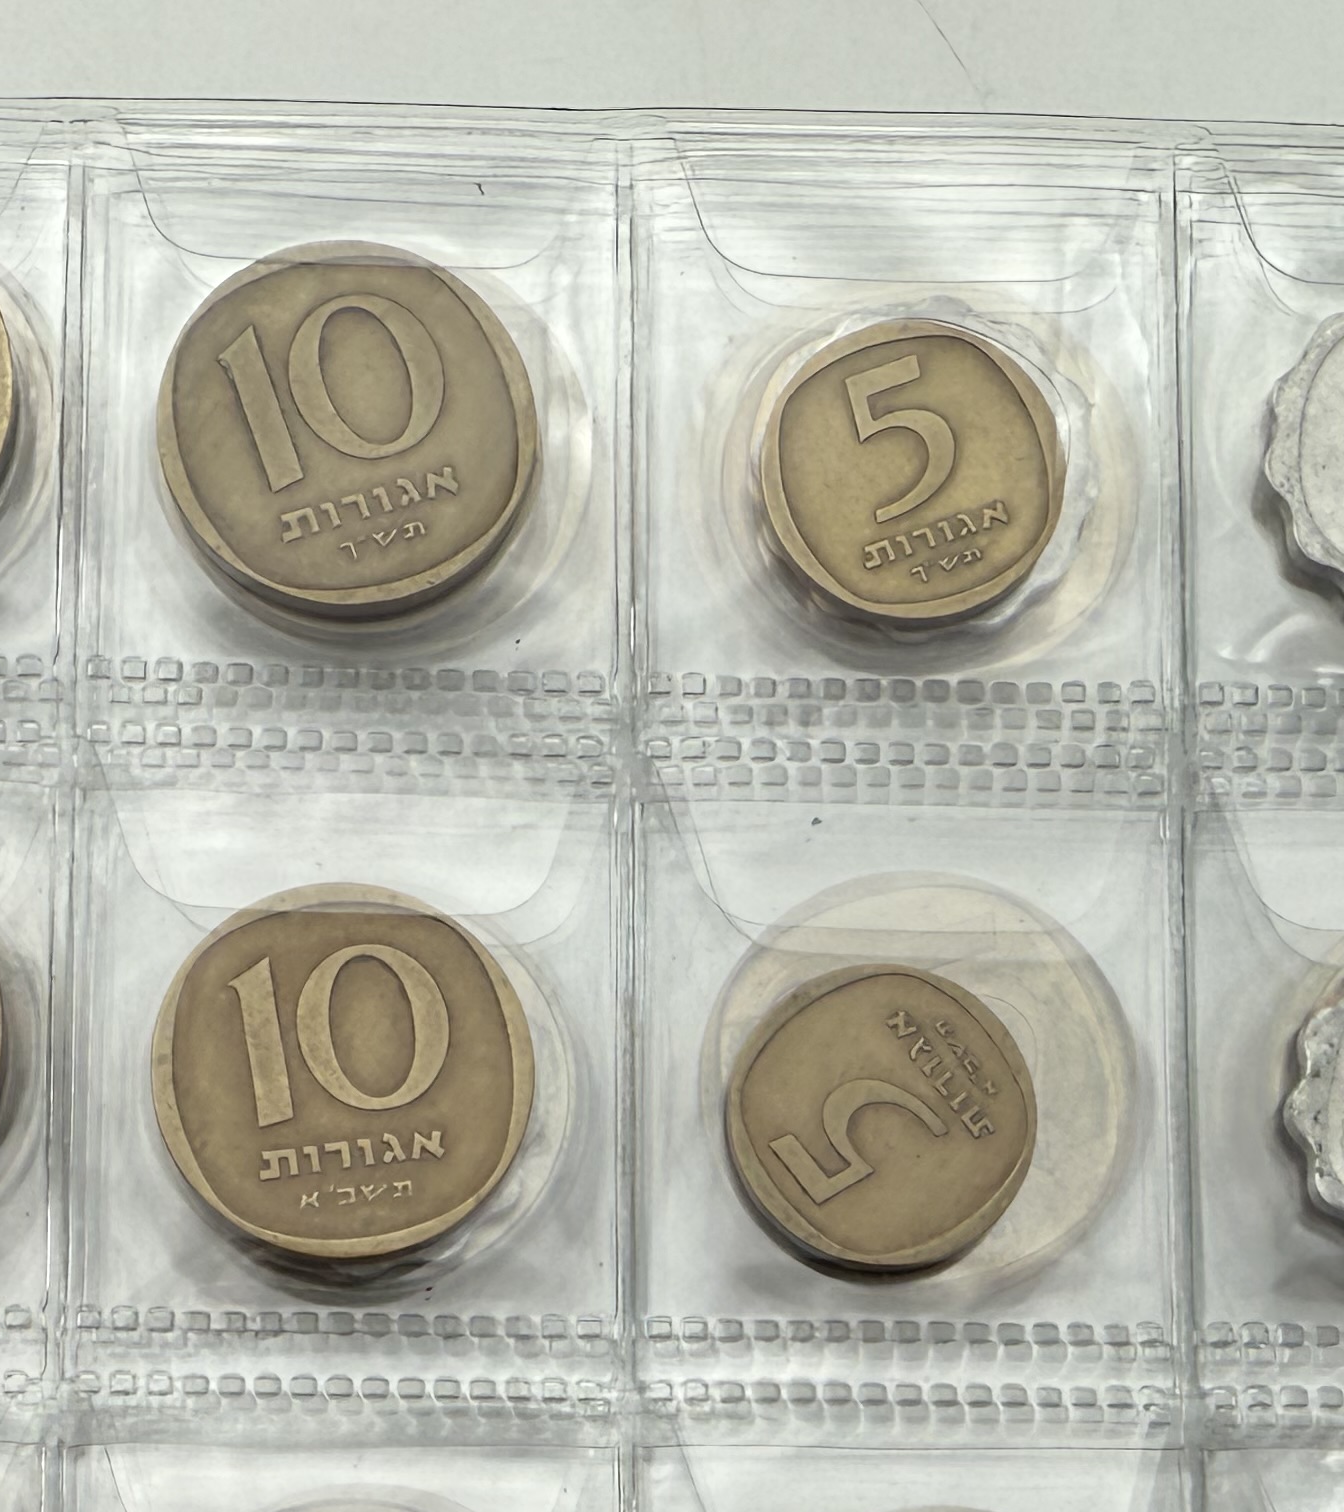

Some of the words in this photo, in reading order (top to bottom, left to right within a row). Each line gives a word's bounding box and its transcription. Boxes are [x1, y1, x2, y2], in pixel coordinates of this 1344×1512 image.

[216, 291, 446, 494] 10
[844, 353, 956, 524] 5
[279, 466, 460, 545] אגורות
[862, 499, 1010, 571] אגורות
[226, 942, 451, 1129] 10
[885, 1009, 996, 1140] אגורות
[258, 1130, 446, 1182] אגורות
[767, 1077, 950, 1206] 5
